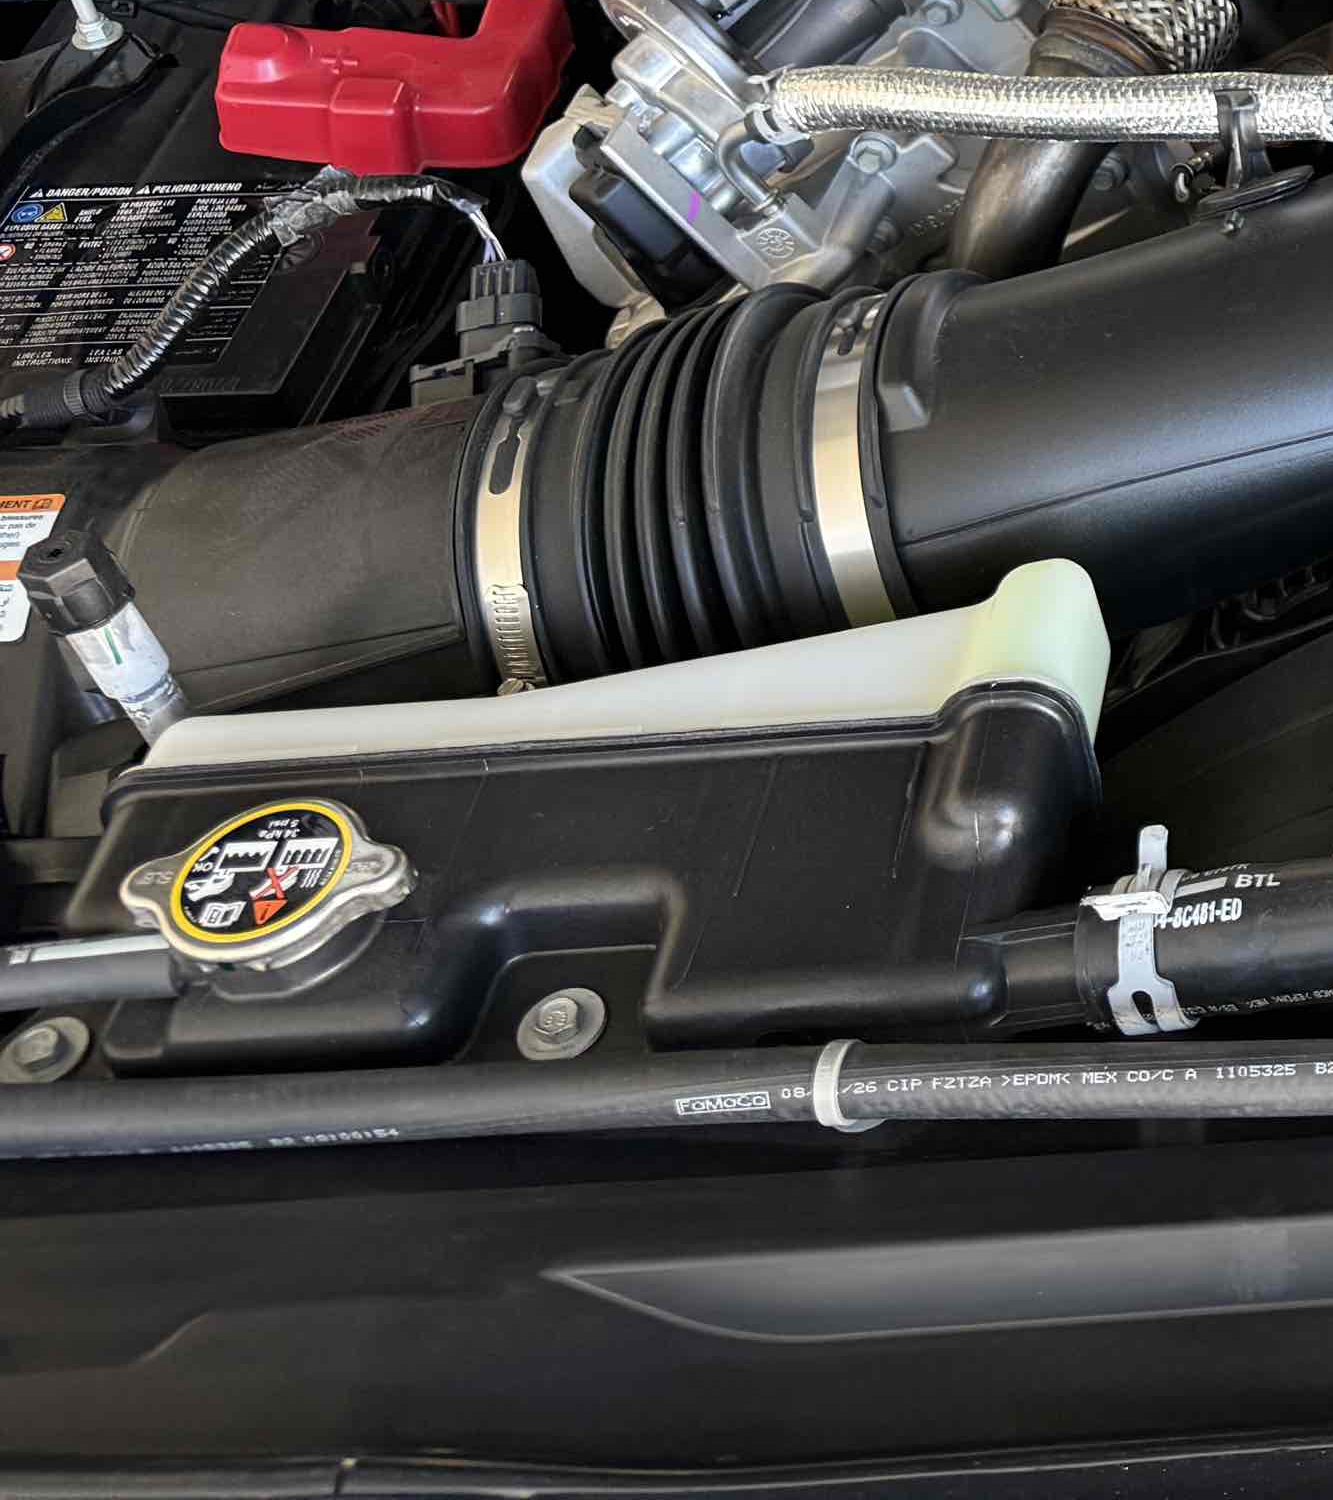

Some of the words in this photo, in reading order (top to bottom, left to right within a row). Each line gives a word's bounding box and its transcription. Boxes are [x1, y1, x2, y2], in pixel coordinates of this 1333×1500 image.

[46, 186, 133, 198] DANGER/POISON
[282, 828, 300, 839] 34
[1234, 873, 1281, 889] BTL
[676, 1091, 772, 1116] FoMoCo
[886, 1078, 923, 1093] CIP
[1000, 1071, 1072, 1089] >EPDM<
[1082, 1068, 1118, 1086] MEX
[1184, 1068, 1198, 1082] A
[1215, 1063, 1298, 1080] 1105325
